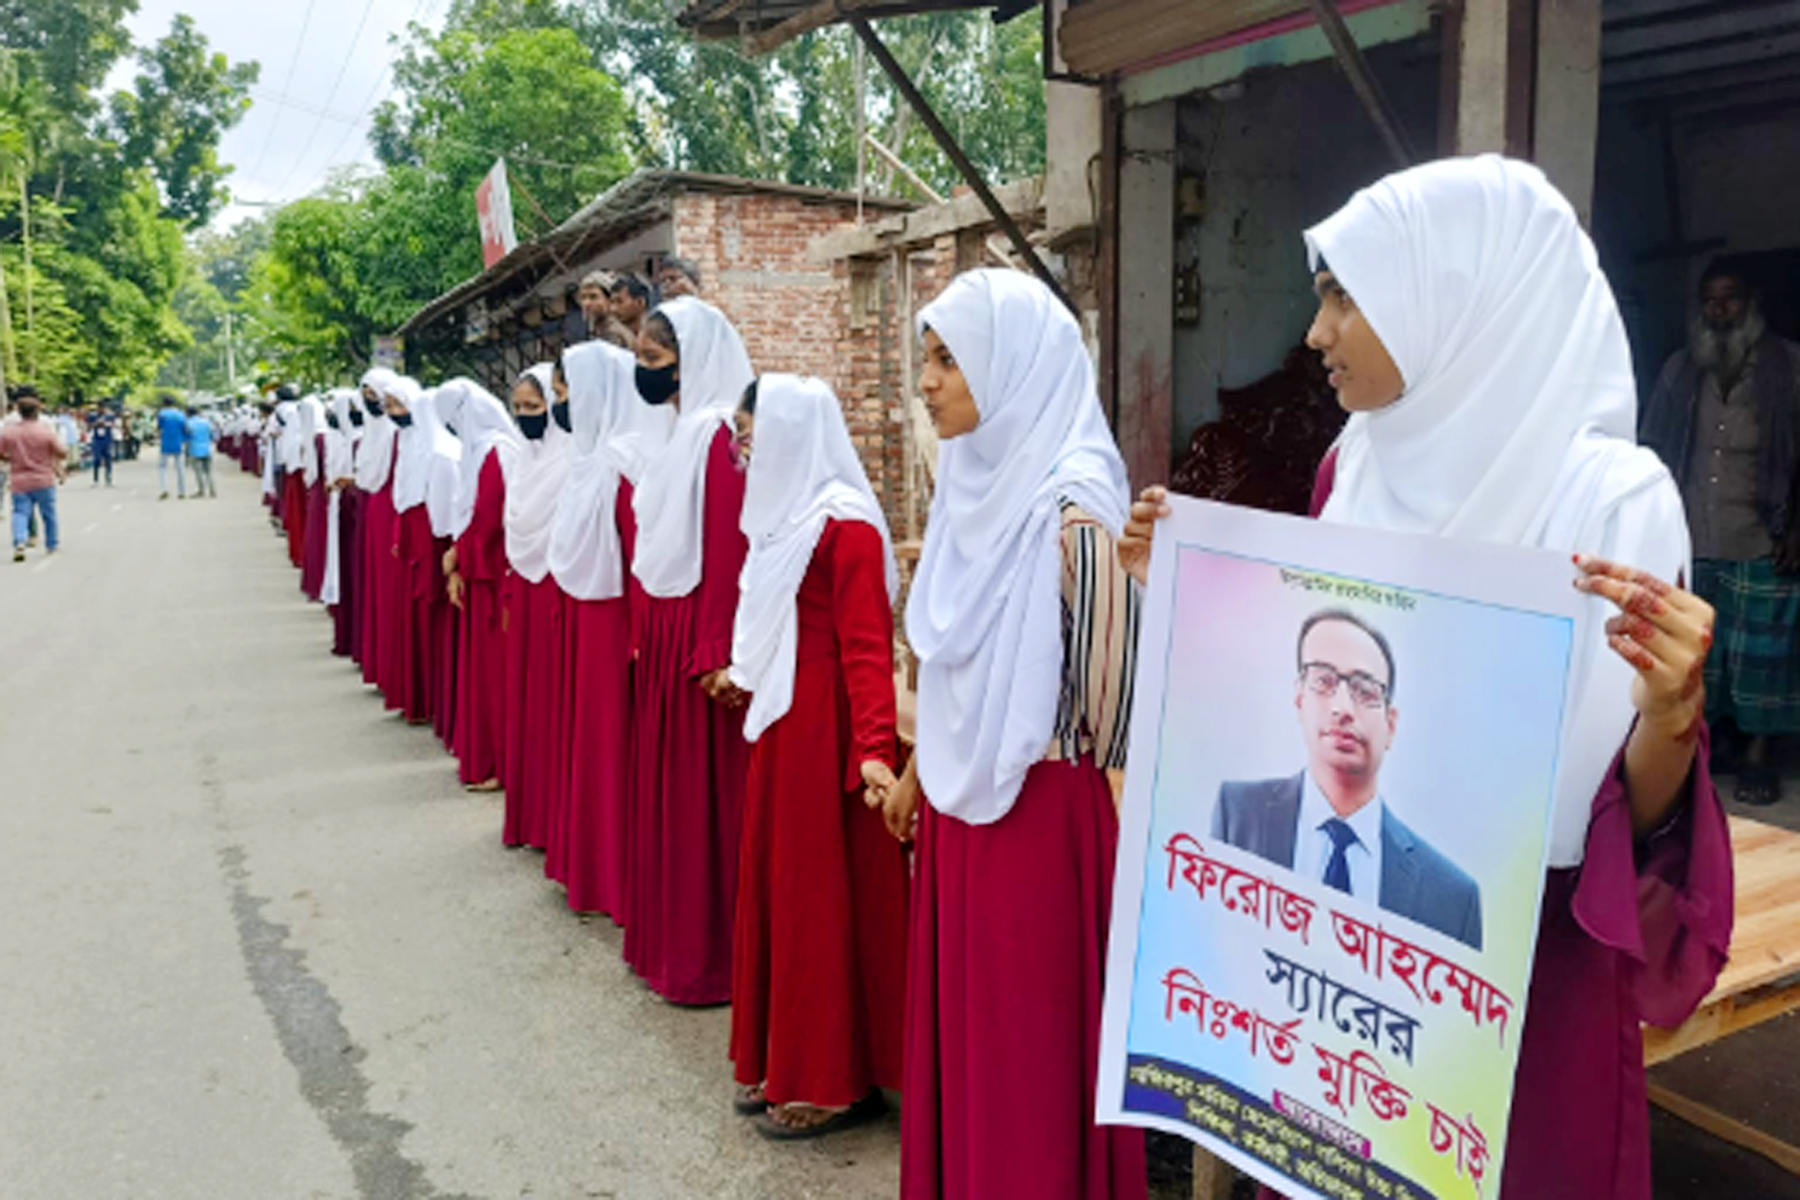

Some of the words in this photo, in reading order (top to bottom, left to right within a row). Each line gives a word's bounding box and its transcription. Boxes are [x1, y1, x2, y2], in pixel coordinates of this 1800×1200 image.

[1164, 833, 1317, 945] ফিরোজ
[1330, 909, 1514, 1049] আহম্মেদ
[1264, 948, 1422, 1065] স্যারের
[1161, 968, 1304, 1065] নিঃশর্ত
[1311, 1043, 1413, 1121] মুক্তি
[1424, 1100, 1490, 1200] চাই
